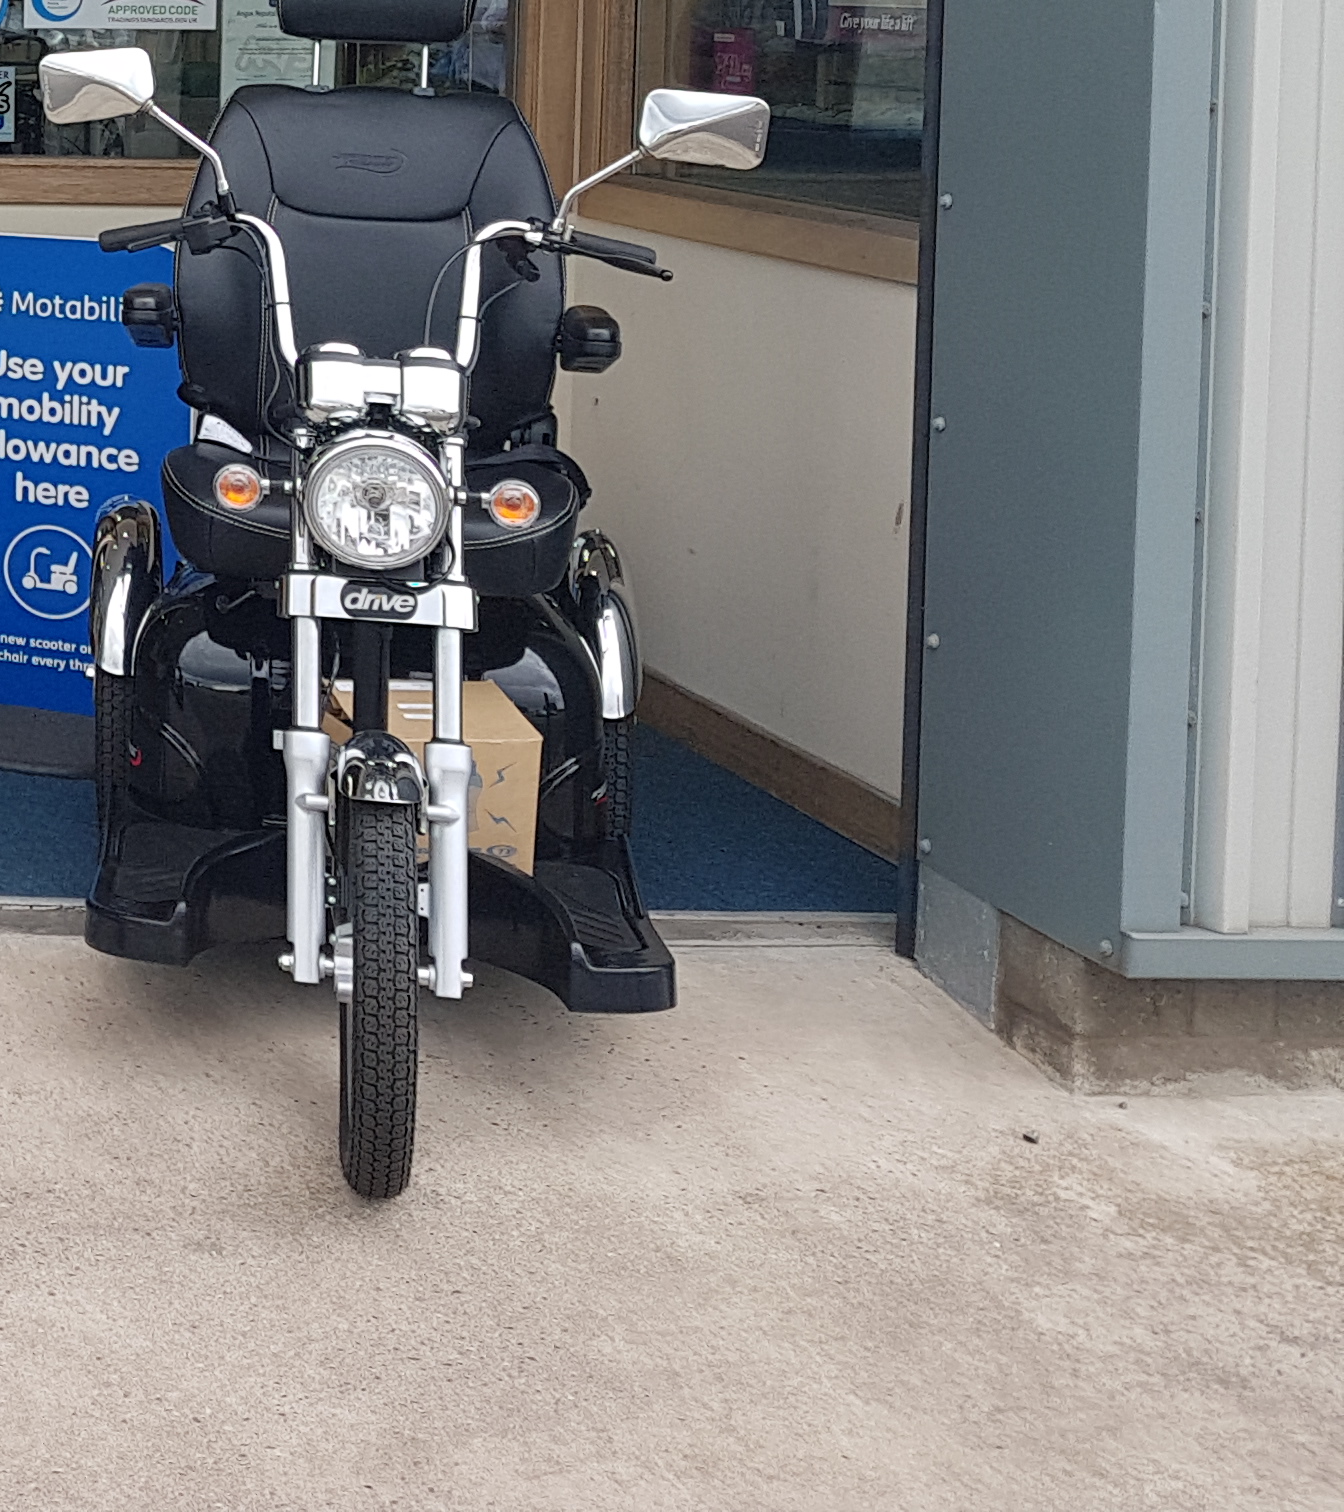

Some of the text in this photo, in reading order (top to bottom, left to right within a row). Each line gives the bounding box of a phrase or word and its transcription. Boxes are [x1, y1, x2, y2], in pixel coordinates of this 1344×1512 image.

[107, 5, 199, 16] APPROVED CODE
[53, 361, 130, 390] your
[15, 471, 90, 508] here
[342, 587, 416, 614] drive
[0, 632, 26, 646] new
[29, 637, 77, 653] scooter
[31, 656, 66, 672] every
